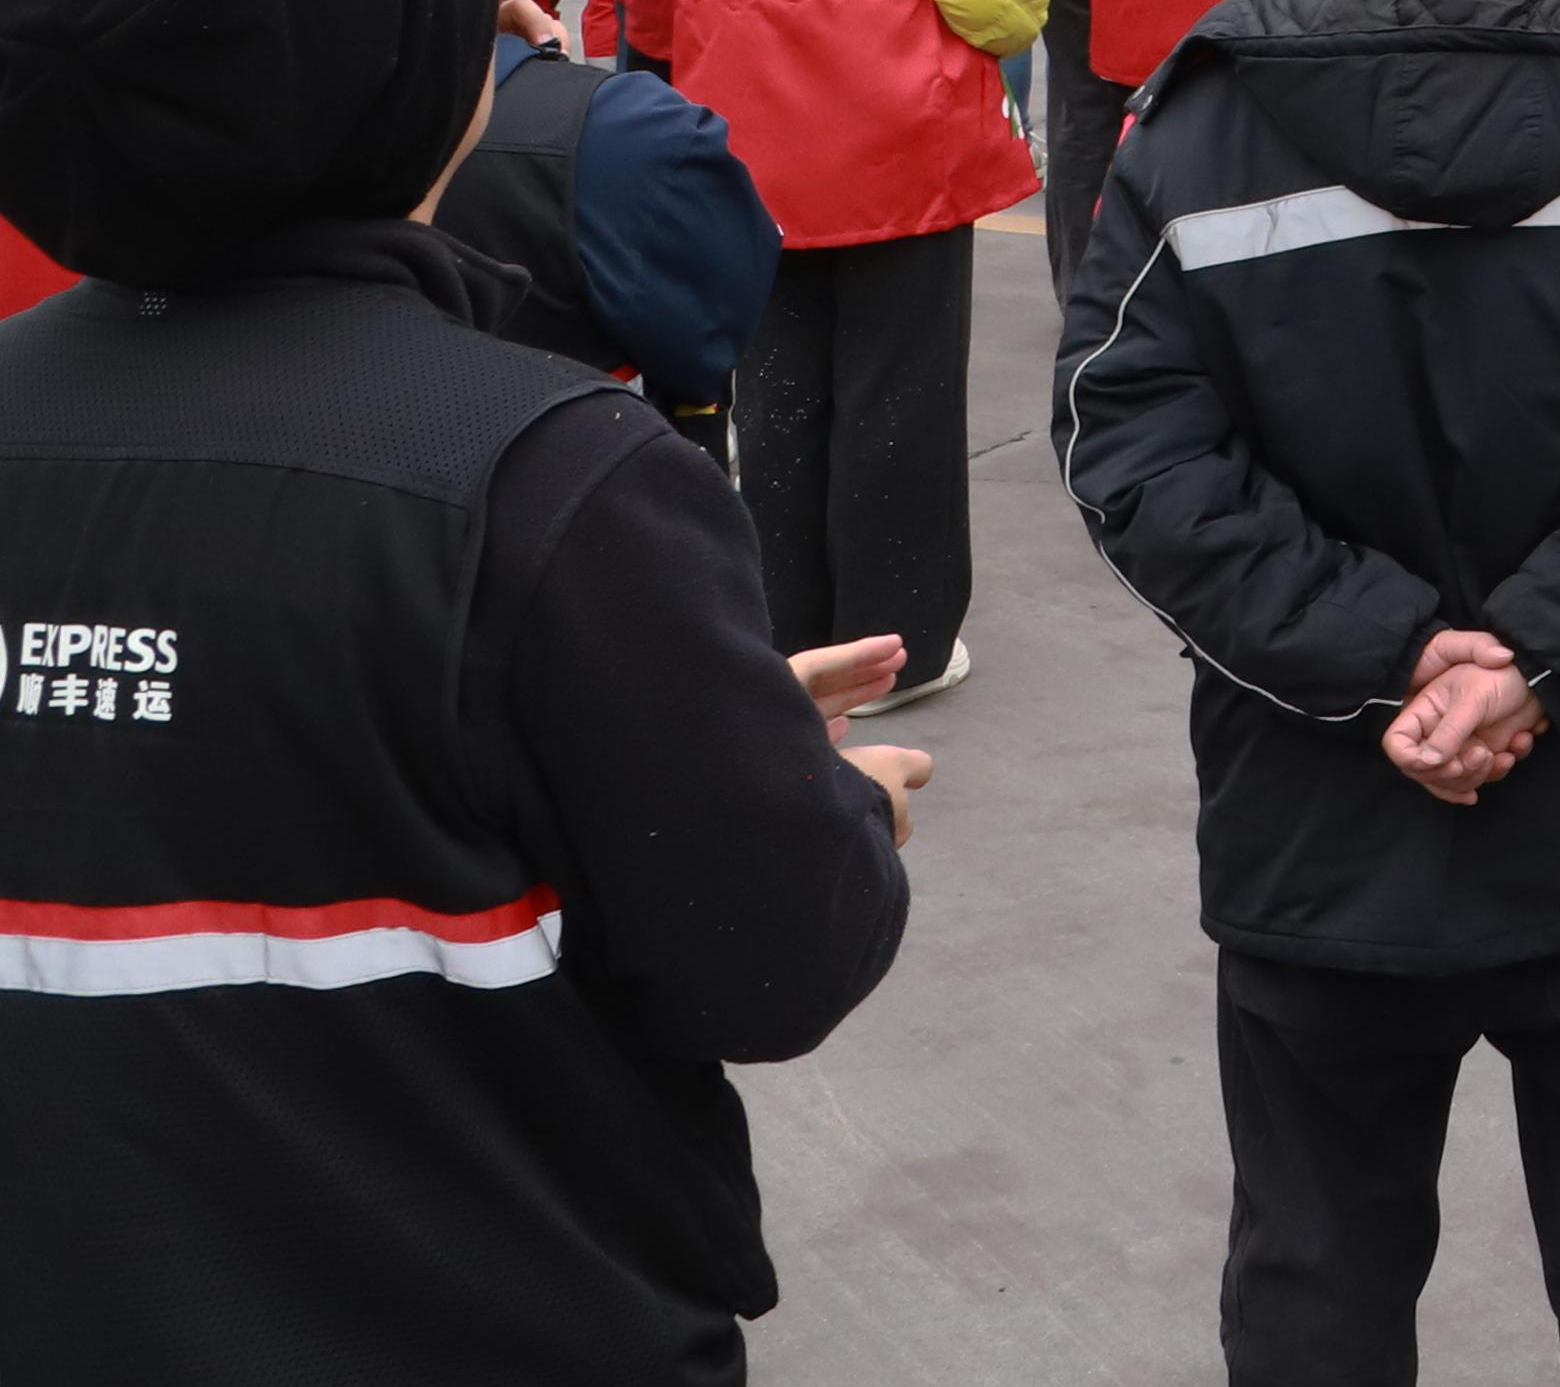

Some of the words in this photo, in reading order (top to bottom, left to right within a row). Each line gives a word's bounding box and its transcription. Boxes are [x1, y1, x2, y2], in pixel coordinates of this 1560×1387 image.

[20, 622, 179, 674] EXPRESS
[15, 673, 173, 722] 顺丰速运
